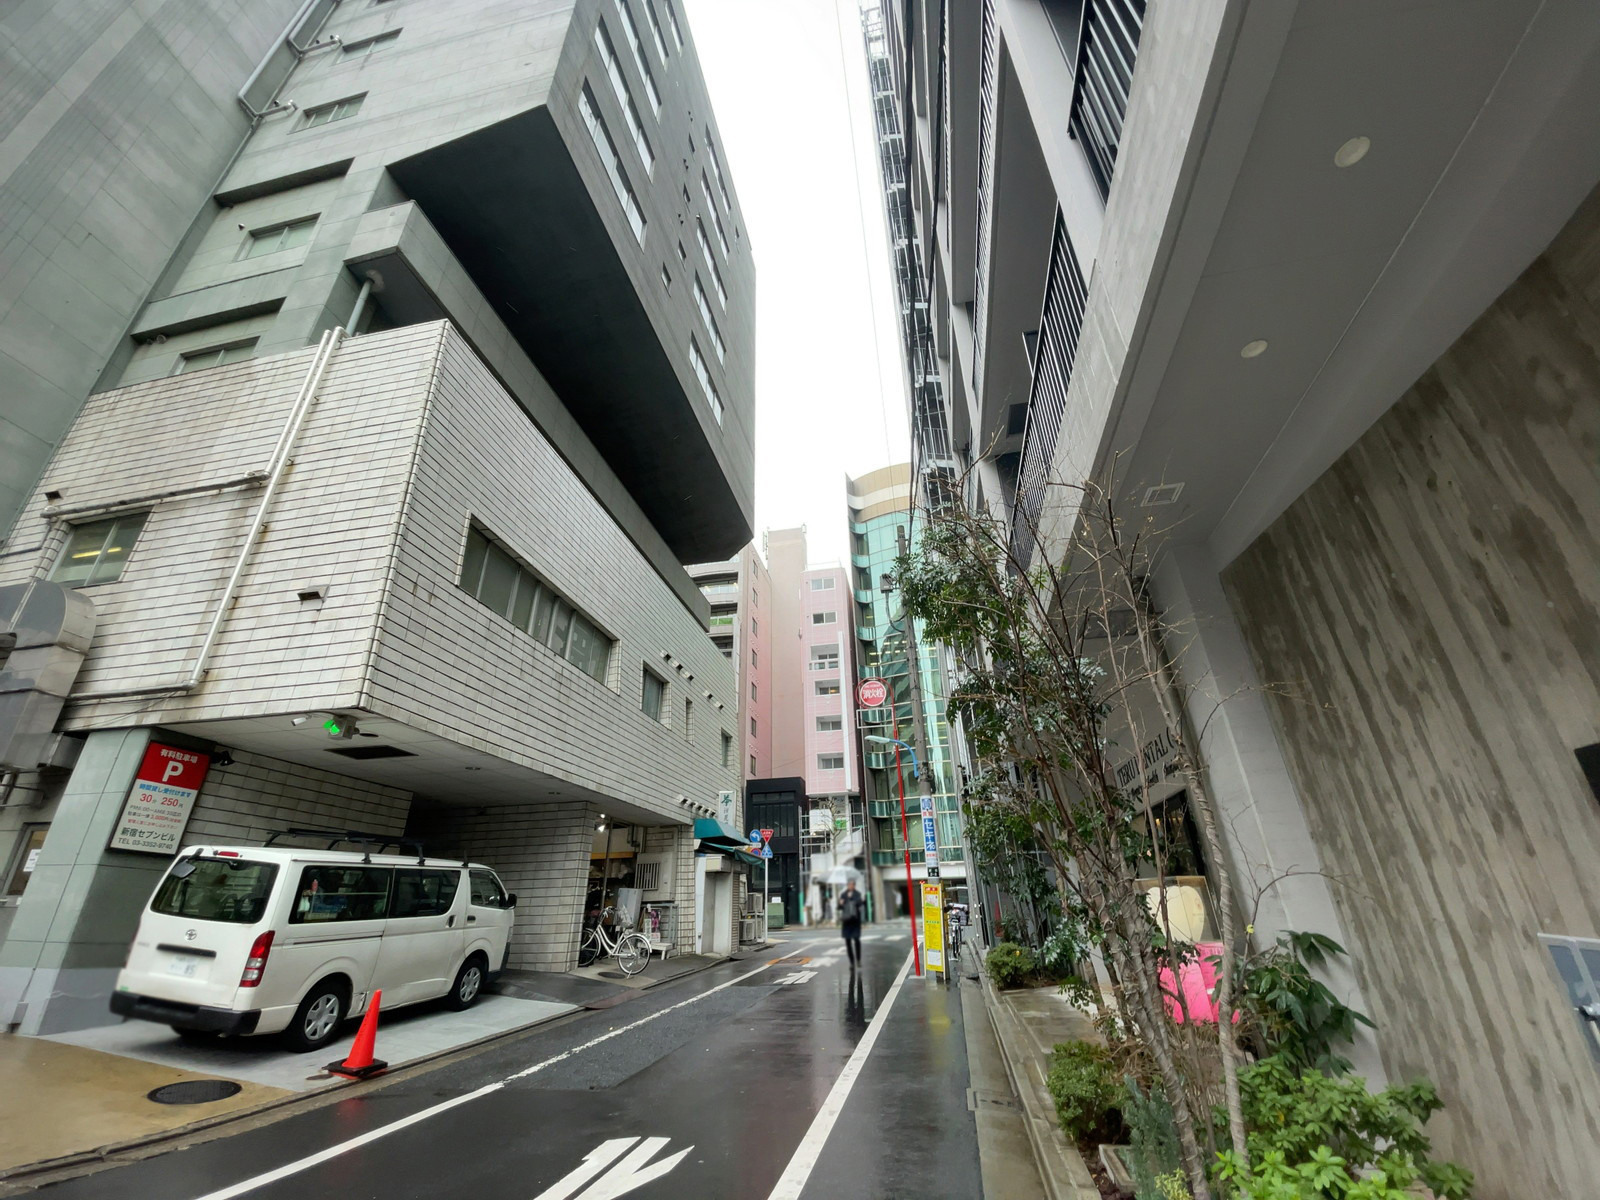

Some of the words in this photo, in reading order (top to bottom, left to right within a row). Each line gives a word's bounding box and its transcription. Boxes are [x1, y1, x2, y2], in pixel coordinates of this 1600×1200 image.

[863, 688, 883, 698] 消火栓
[160, 748, 198, 764] 有料駐車場
[162, 761, 184, 782] P
[121, 827, 176, 841] 新宿セブンビル
